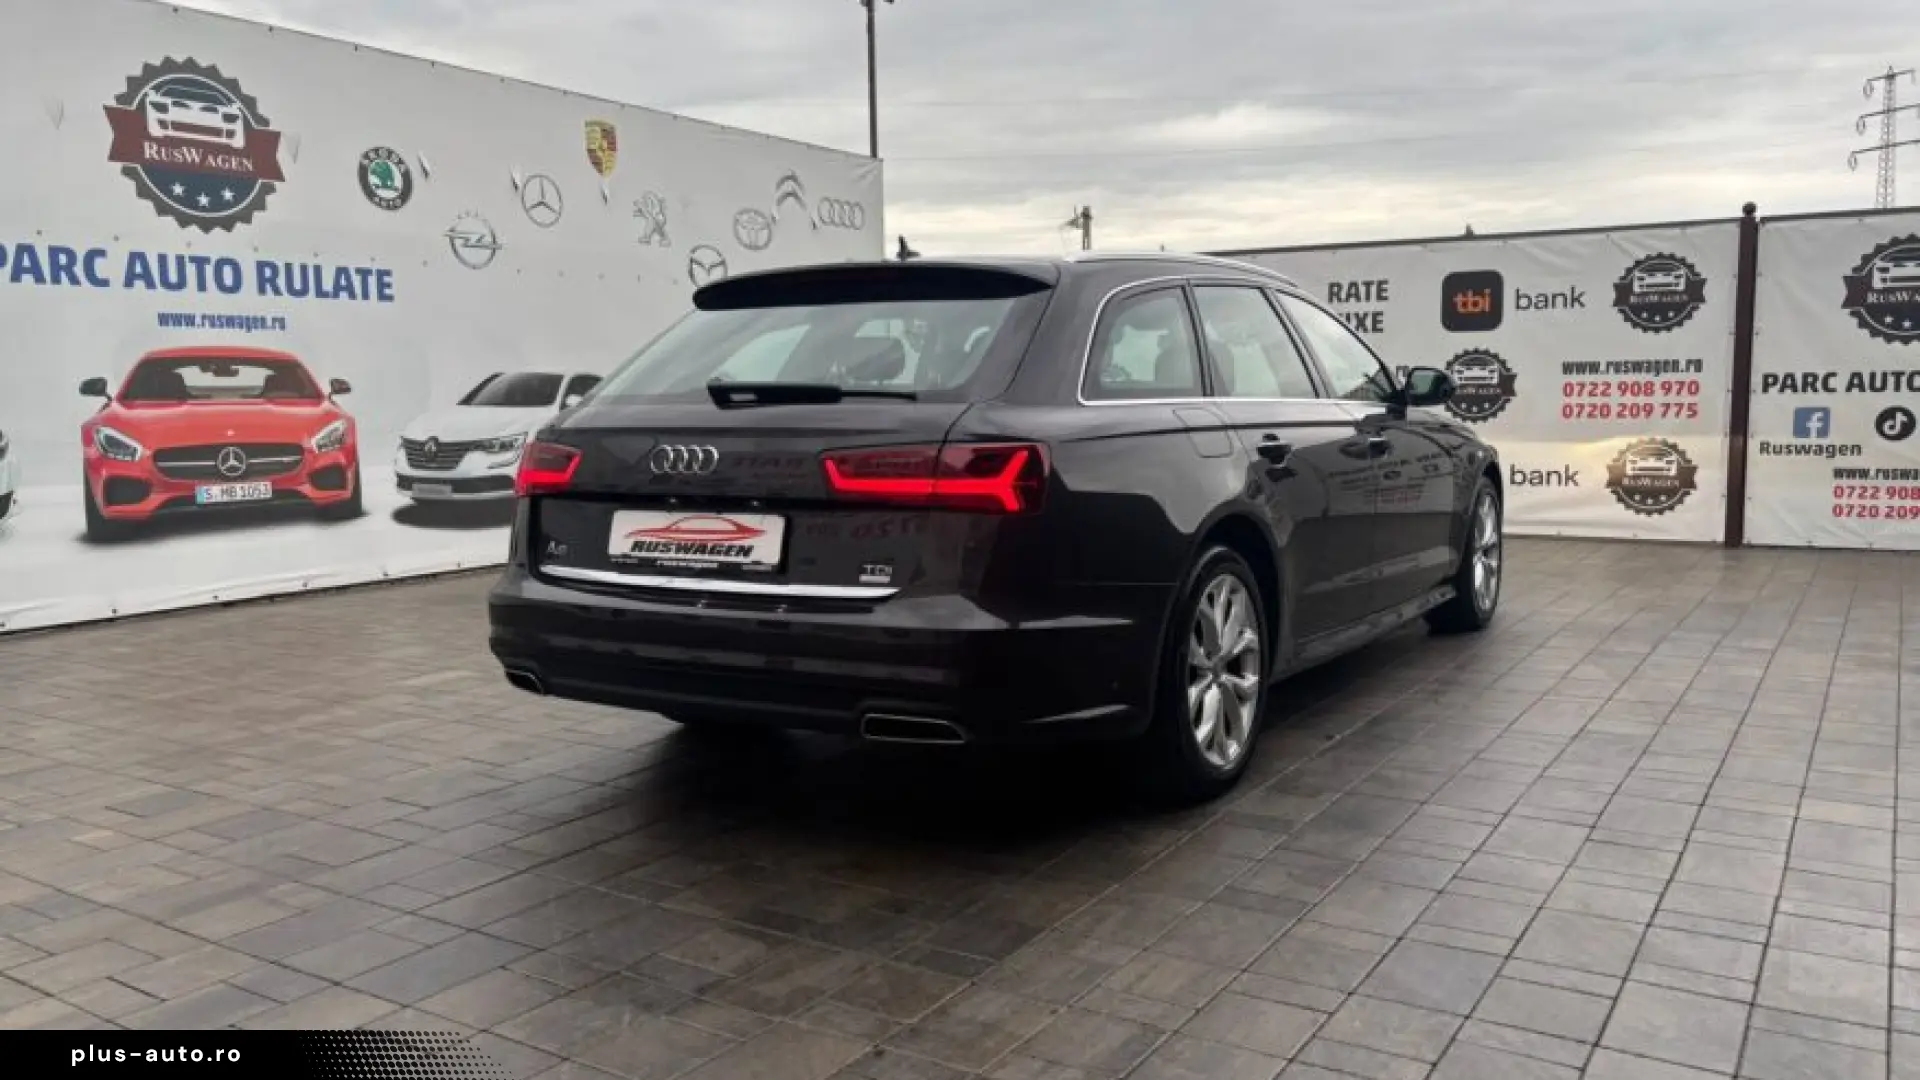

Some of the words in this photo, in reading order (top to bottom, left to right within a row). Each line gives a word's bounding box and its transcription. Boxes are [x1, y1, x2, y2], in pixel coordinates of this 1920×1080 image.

[122, 251, 244, 295] AUTO
[255, 260, 395, 303] RULATE
[1327, 280, 1389, 303] RATE
[1453, 288, 1492, 314] tbi
[1515, 285, 1586, 311] bank
[157, 312, 286, 333] www.ruswagen.ro
[1337, 310, 1384, 333] IXE
[1562, 358, 1703, 377] www.ruswagen.ro
[1562, 382, 1612, 397] 0722
[1616, 380, 1655, 397] 908
[1660, 380, 1700, 397] 970
[1761, 371, 1838, 393] PARC
[1562, 402, 1612, 419] 0720
[1616, 402, 1655, 419] 209
[1659, 402, 1699, 419] 775
[1759, 441, 1862, 459] Ruswagen
[1509, 463, 1579, 487] bank
[1832, 485, 1881, 500] 0722
[1832, 503, 1879, 518] 0720
[630, 540, 755, 557] RUSWAGEN
